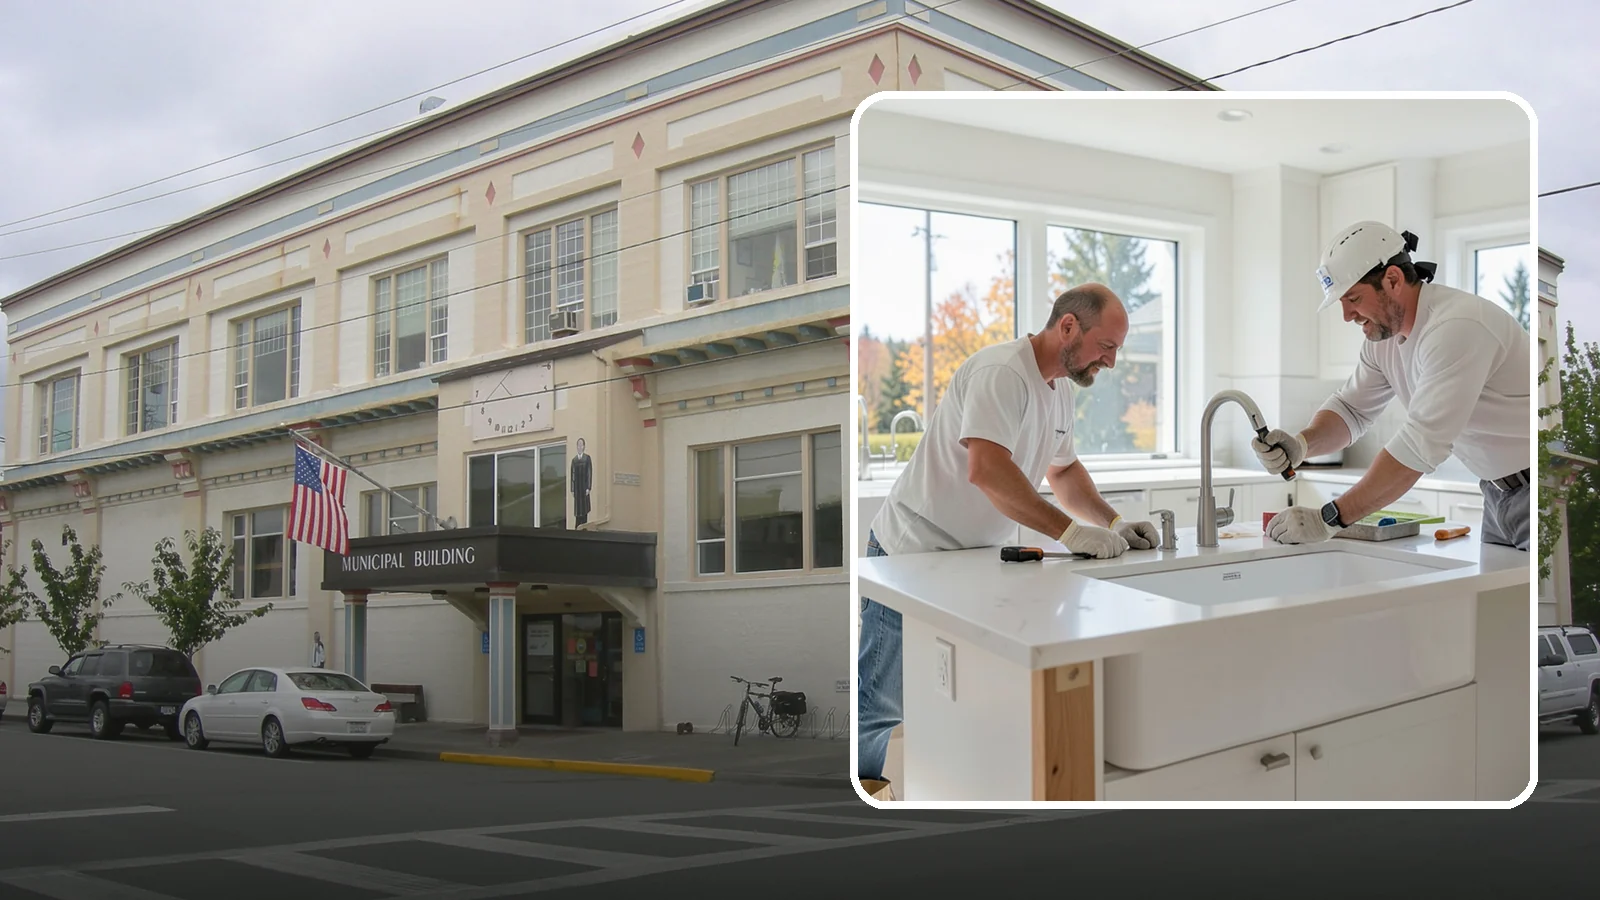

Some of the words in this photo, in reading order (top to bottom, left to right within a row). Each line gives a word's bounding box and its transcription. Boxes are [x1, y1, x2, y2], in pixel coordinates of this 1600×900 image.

[487, 417, 493, 426] 9
[494, 423, 501, 432] 10
[507, 425, 514, 434] 12
[342, 552, 405, 572] MUNICIPAL
[414, 546, 475, 567] BUILDING
